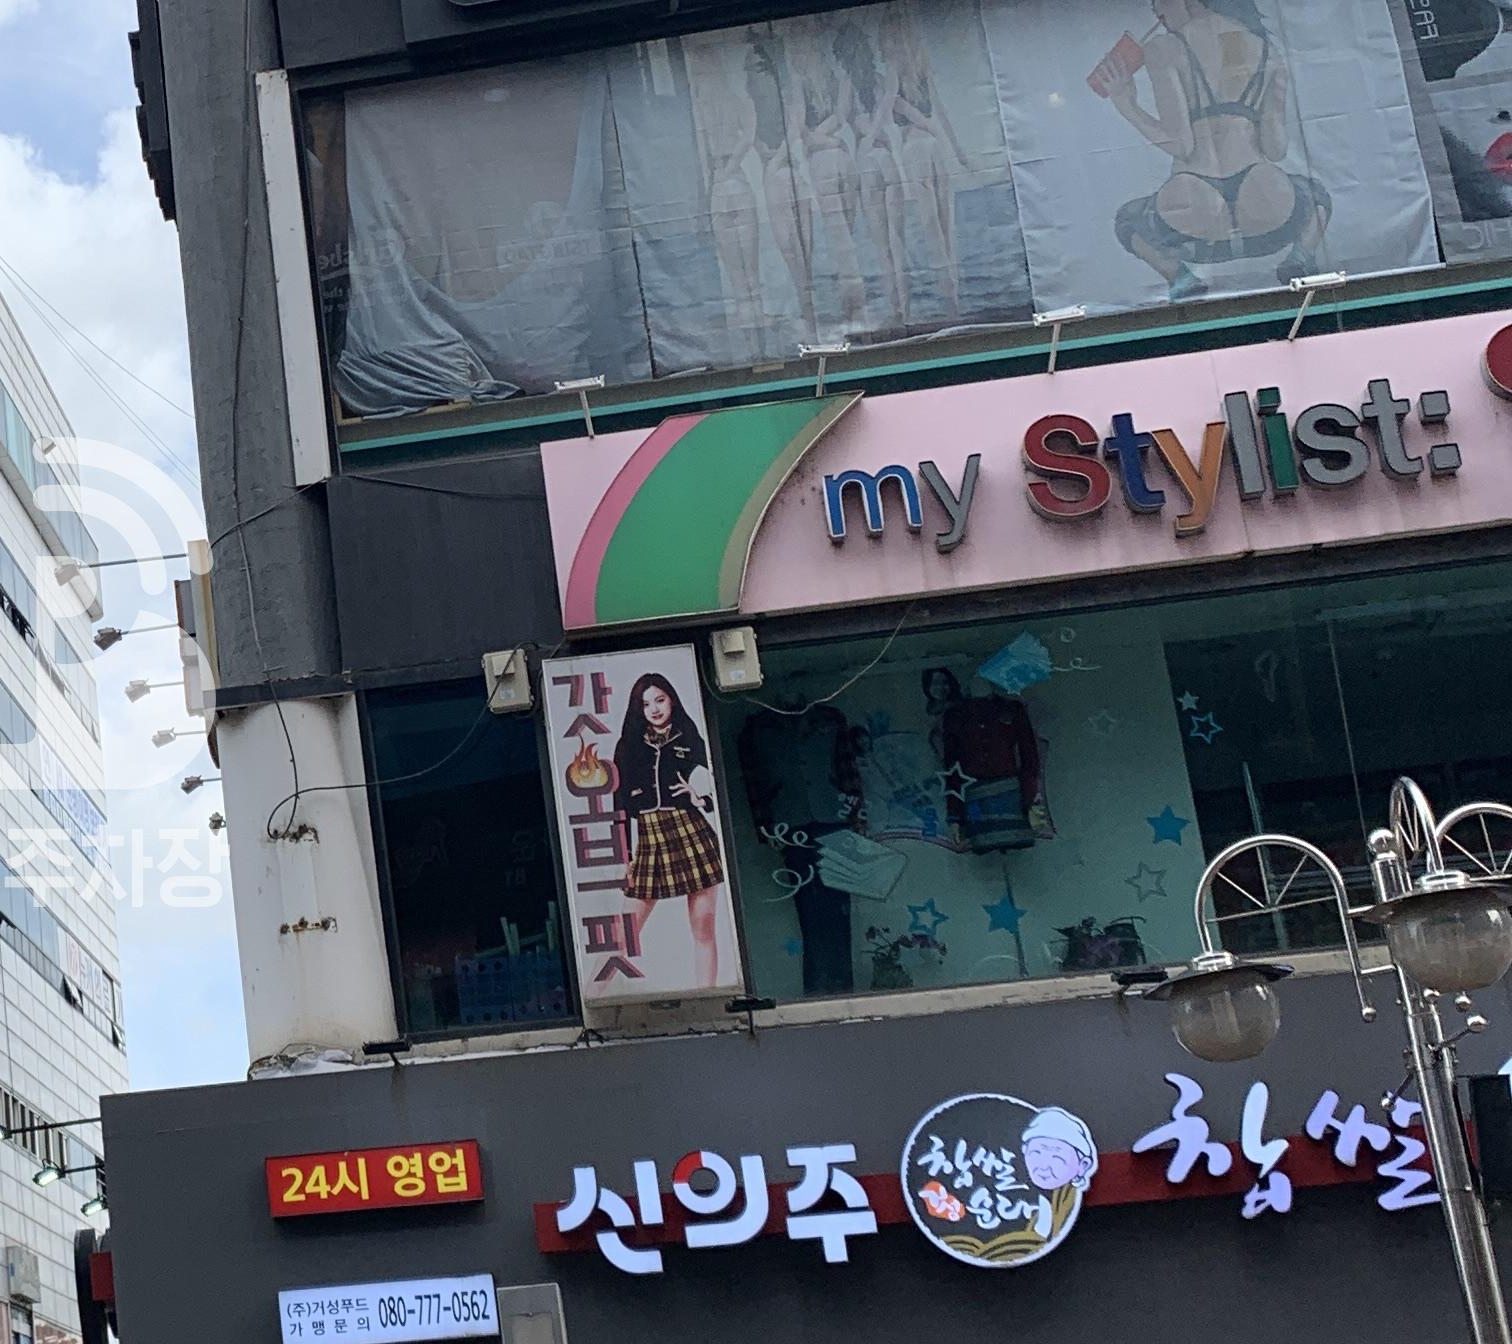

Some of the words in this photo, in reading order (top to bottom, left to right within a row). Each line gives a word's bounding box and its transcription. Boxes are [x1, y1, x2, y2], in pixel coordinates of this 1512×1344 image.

[823, 452, 982, 554] my
[281, 1158, 370, 1204] 24시
[387, 1148, 469, 1197] 영업
[555, 1142, 879, 1275] 신의주
[287, 1297, 371, 1319] (주)거성푸드
[378, 1289, 491, 1329] 080-777-0562
